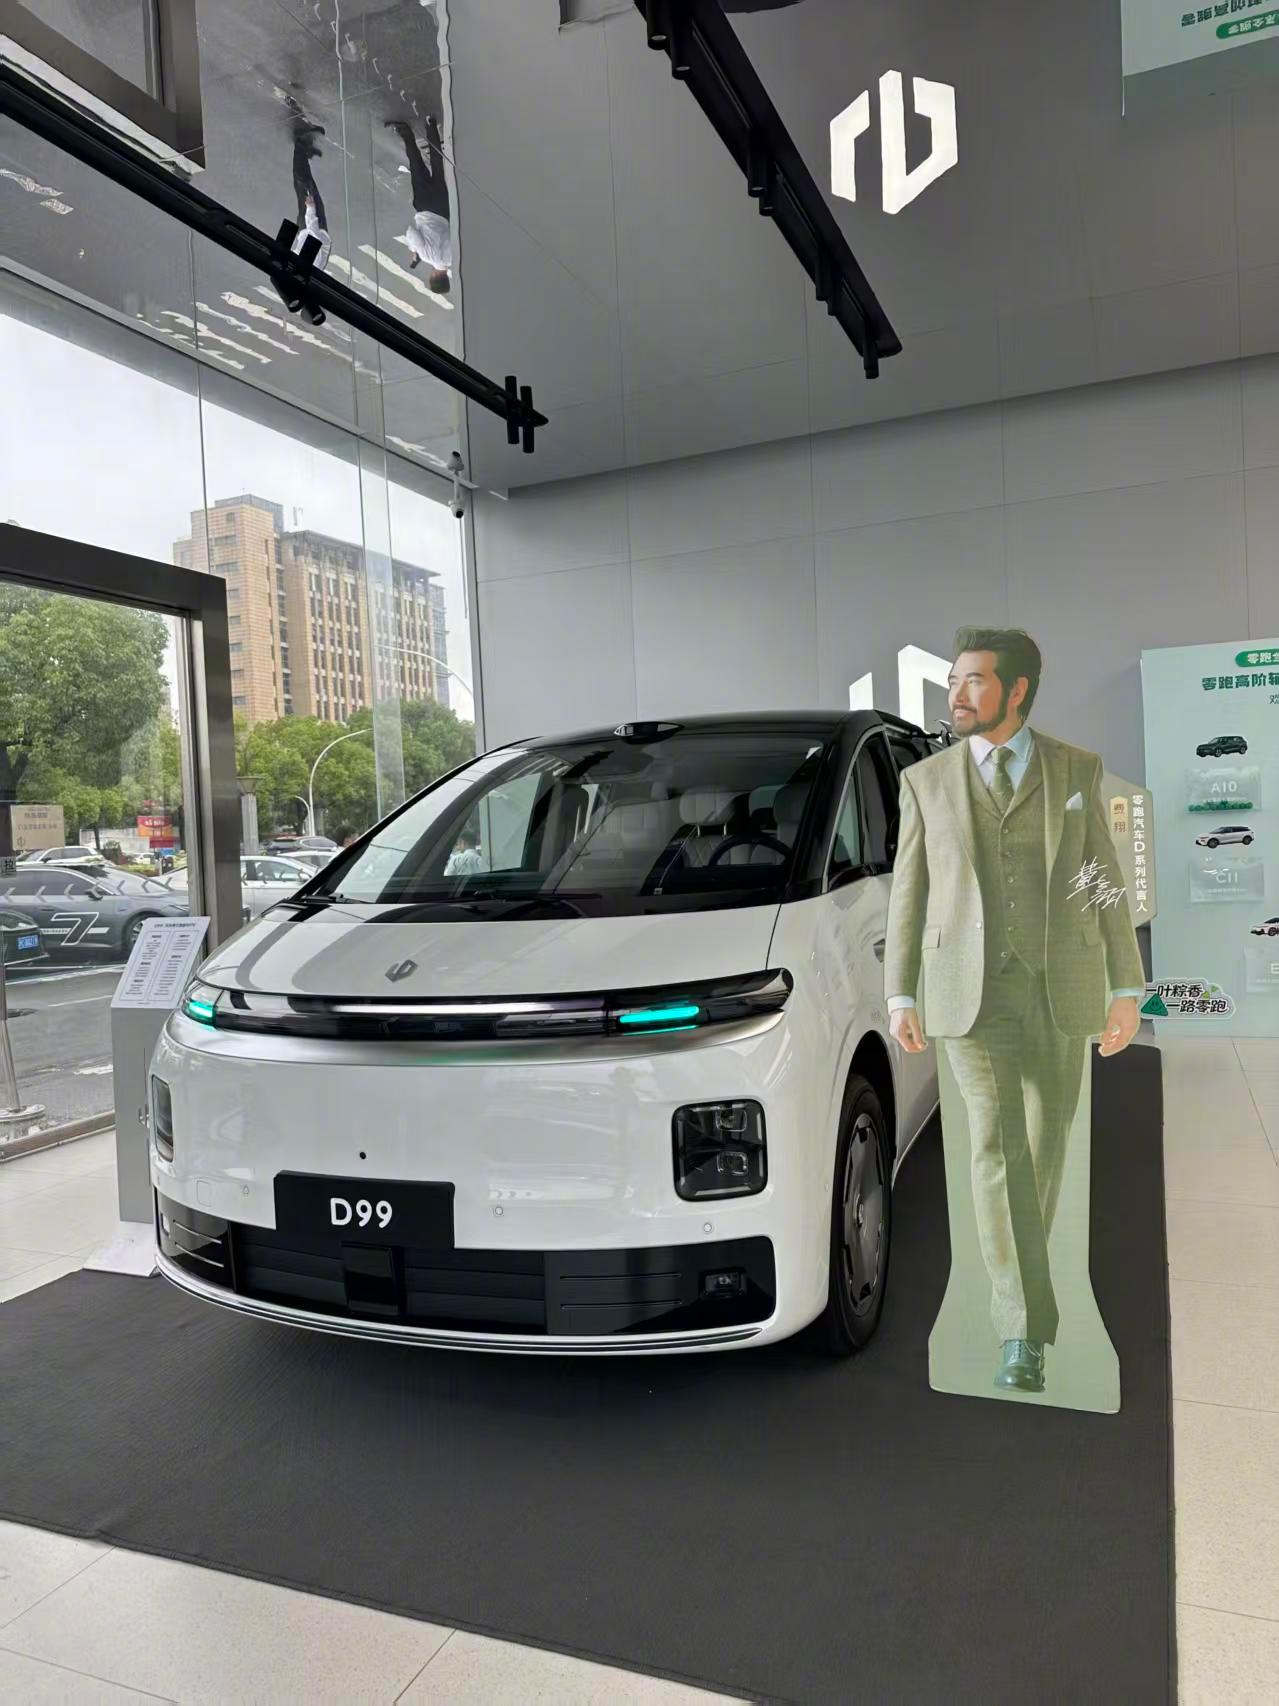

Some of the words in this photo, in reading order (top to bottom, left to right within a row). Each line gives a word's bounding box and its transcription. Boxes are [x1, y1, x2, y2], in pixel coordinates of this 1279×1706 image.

[1211, 780, 1237, 793] A10
[1132, 795, 1148, 912] 零跑汽车D系列代言人
[1146, 984, 1203, 998] 一叶粽香
[1166, 1000, 1228, 1013] 一路零跑
[330, 1197, 393, 1229] D99
